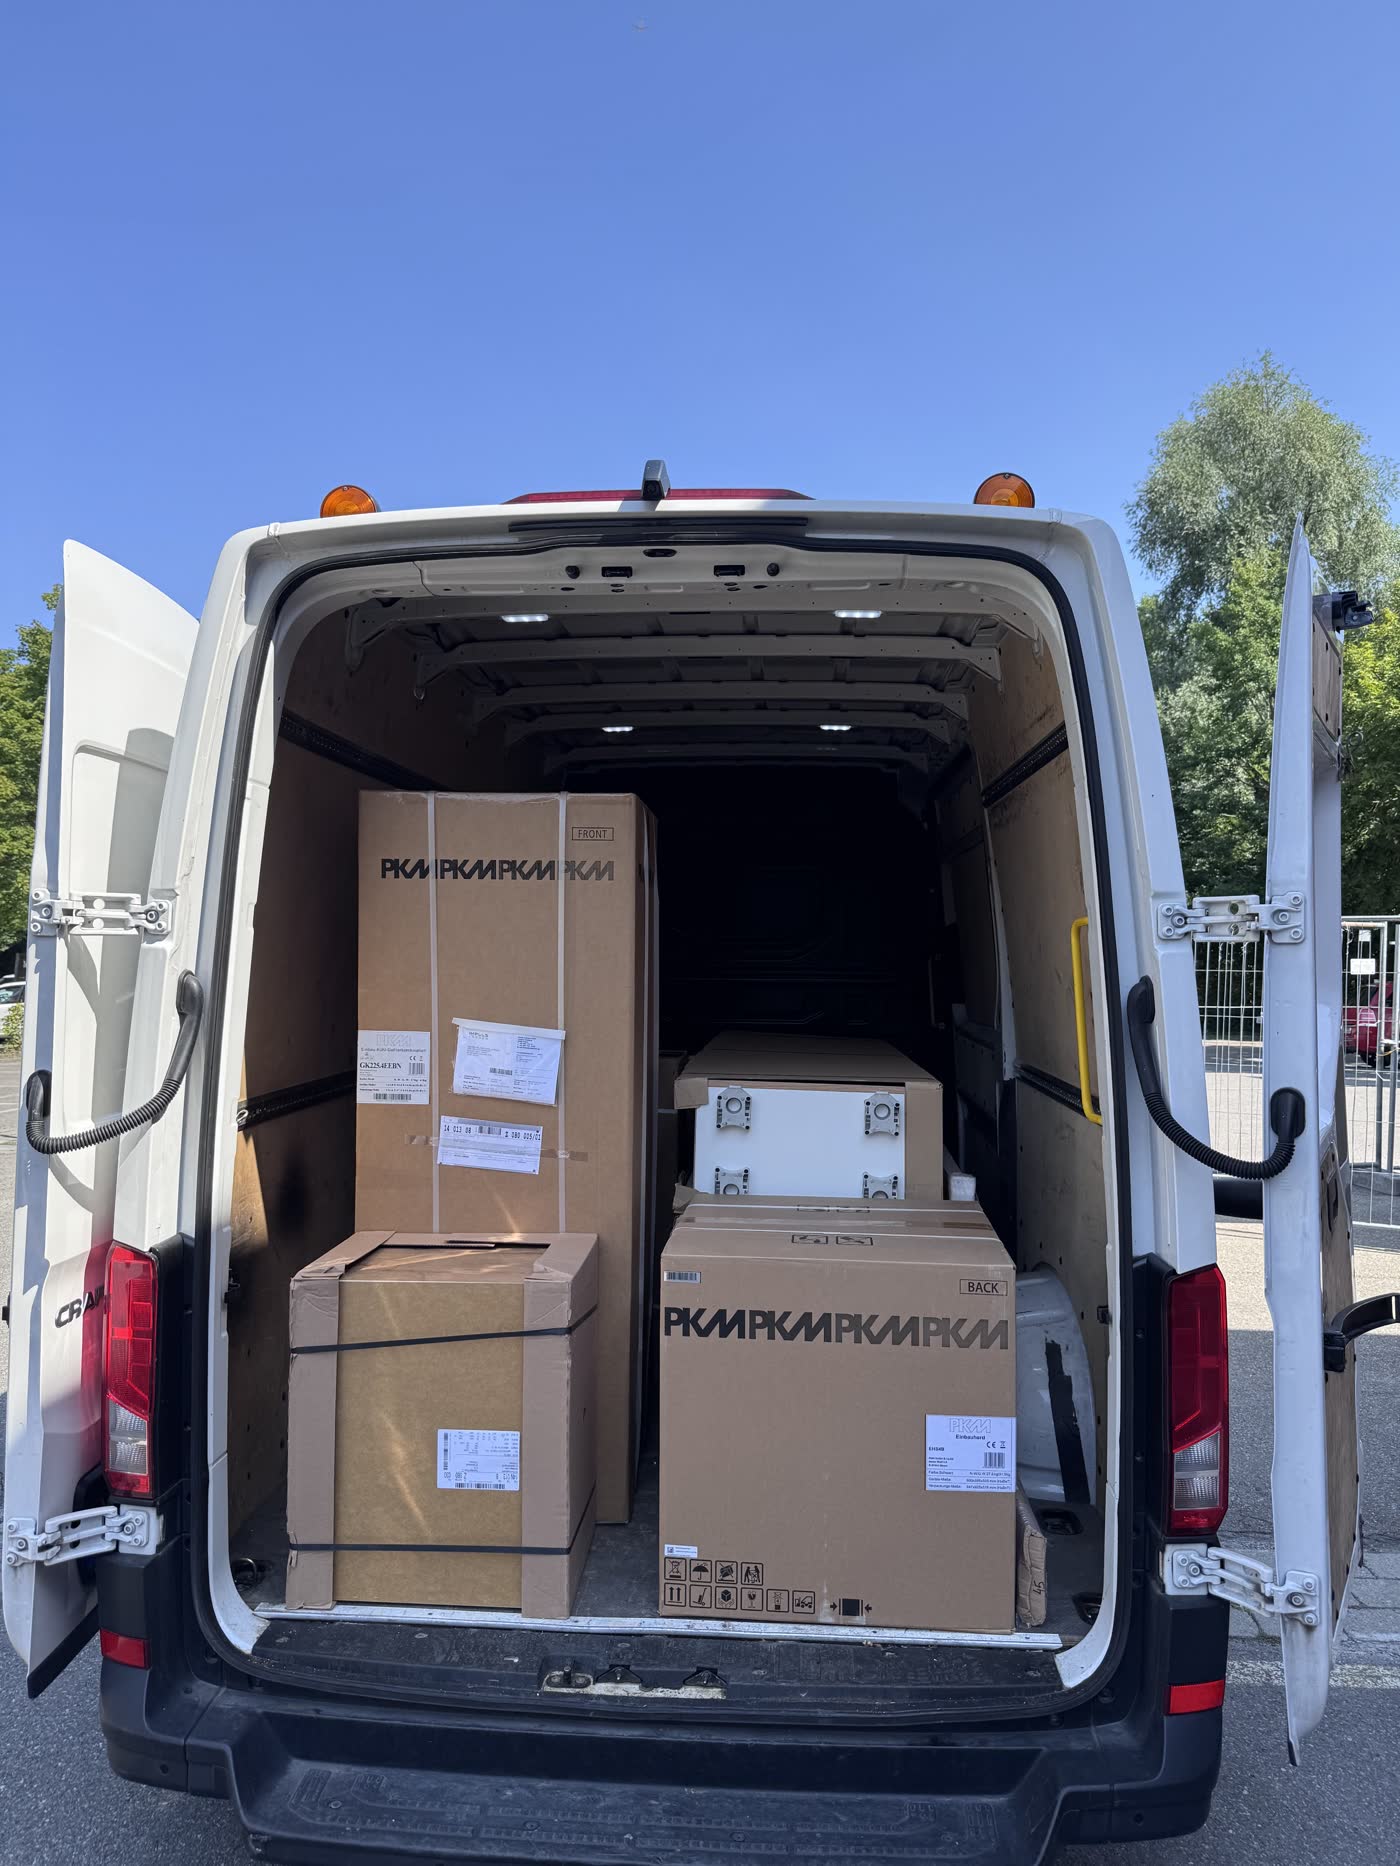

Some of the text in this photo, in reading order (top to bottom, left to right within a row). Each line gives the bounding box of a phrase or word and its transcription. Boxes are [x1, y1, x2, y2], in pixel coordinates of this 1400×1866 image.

[578, 829, 608, 839] FRONT
[967, 1281, 1000, 1294] BACK
[664, 1306, 1009, 1350] PKM PKM PKM PKM
[949, 1417, 992, 1434] PKM
[1032, 1579, 1045, 1595] 45
